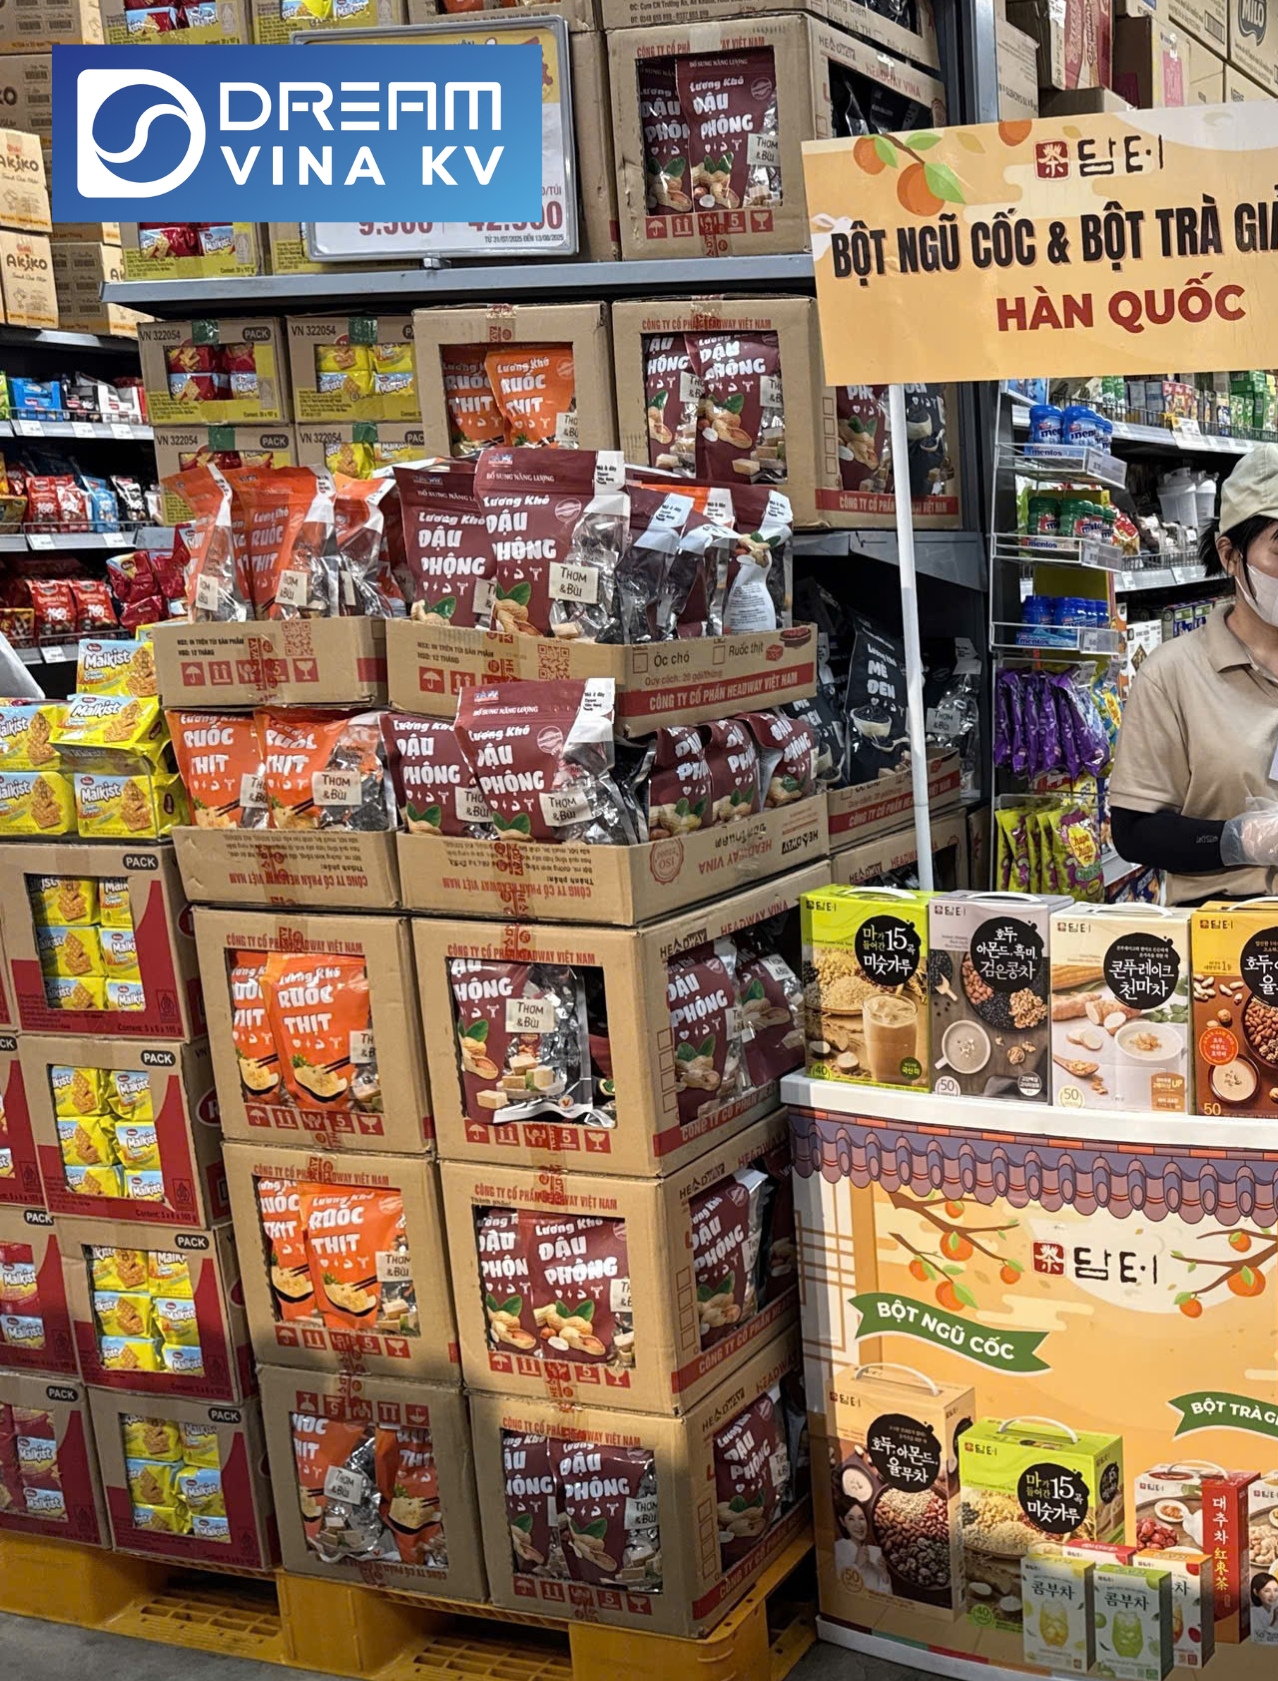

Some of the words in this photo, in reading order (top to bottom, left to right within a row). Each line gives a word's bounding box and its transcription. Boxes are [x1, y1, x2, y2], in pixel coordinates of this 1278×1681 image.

[700, 115, 753, 140] PHỘNG
[1078, 134, 1164, 177] 담터
[832, 222, 888, 287] BỘT
[898, 212, 961, 274] NGŨ
[970, 211, 1036, 269] CỐC
[1047, 222, 1070, 265] &
[1081, 201, 1144, 272] BỘT
[1155, 193, 1223, 256] TRÀ
[6, 252, 48, 271] Akiko
[996, 285, 1095, 333] HÀN
[1107, 272, 1247, 334] QUỐC
[139, 331, 152, 341] VN
[153, 330, 181, 340] 322054
[244, 330, 269, 339] PACK
[291, 326, 304, 336] VN
[306, 325, 336, 336] 322054
[506, 396, 544, 416] THỊT
[157, 436, 169, 446] VN
[171, 435, 198, 445] 322054
[263, 437, 286, 445] PACK
[486, 509, 528, 535] ĐẬU
[418, 526, 462, 551] ĐẬU
[560, 566, 587, 583] THƠM
[85, 650, 131, 669] Malkist
[650, 693, 674, 711] CÔNG
[677, 693, 687, 706] TY
[727, 681, 762, 698] HEADWAY
[781, 671, 798, 685] NAM
[72, 700, 121, 717] Malkist
[322, 774, 351, 786] THƠM
[403, 762, 460, 787] PHỘNG
[480, 770, 544, 795] PHỘNG
[81, 782, 121, 802] Malkist
[548, 796, 577, 808] THƠM
[126, 857, 156, 868] PACK
[862, 953, 914, 977] 미숫가루
[979, 960, 1036, 981] 검은콩차
[1120, 977, 1168, 1000] 천마차
[517, 1001, 544, 1015] THƠM
[284, 1013, 333, 1036] THỊT
[144, 1053, 172, 1064] PACK
[939, 1079, 955, 1091] 50
[1063, 1088, 1079, 1100] 50
[1203, 1102, 1221, 1115] 50
[27, 1213, 52, 1223] PACK
[178, 1237, 206, 1247] PACK
[311, 1232, 361, 1257] THỊT
[538, 1234, 587, 1261] ĐẬU
[544, 1256, 617, 1286] PHỘNG
[1074, 1246, 1158, 1285] 담터
[7, 1326, 45, 1340] Malkist
[877, 1300, 919, 1326] BỘT
[920, 1313, 966, 1346] NGŨ
[968, 1333, 1016, 1362] CỐC
[48, 1388, 75, 1399] PACK
[211, 1410, 239, 1421] PACK
[1190, 1397, 1227, 1416] BỘT
[1229, 1401, 1262, 1421] TRÀ
[560, 1452, 601, 1476] ĐẬU
[886, 1458, 929, 1484] 율무차
[1027, 1502, 1081, 1525] 미숫가루
[1212, 1495, 1229, 1545] 대추차
[1031, 1580, 1077, 1601] 콤부차
[1103, 1591, 1150, 1612] 콤부차
